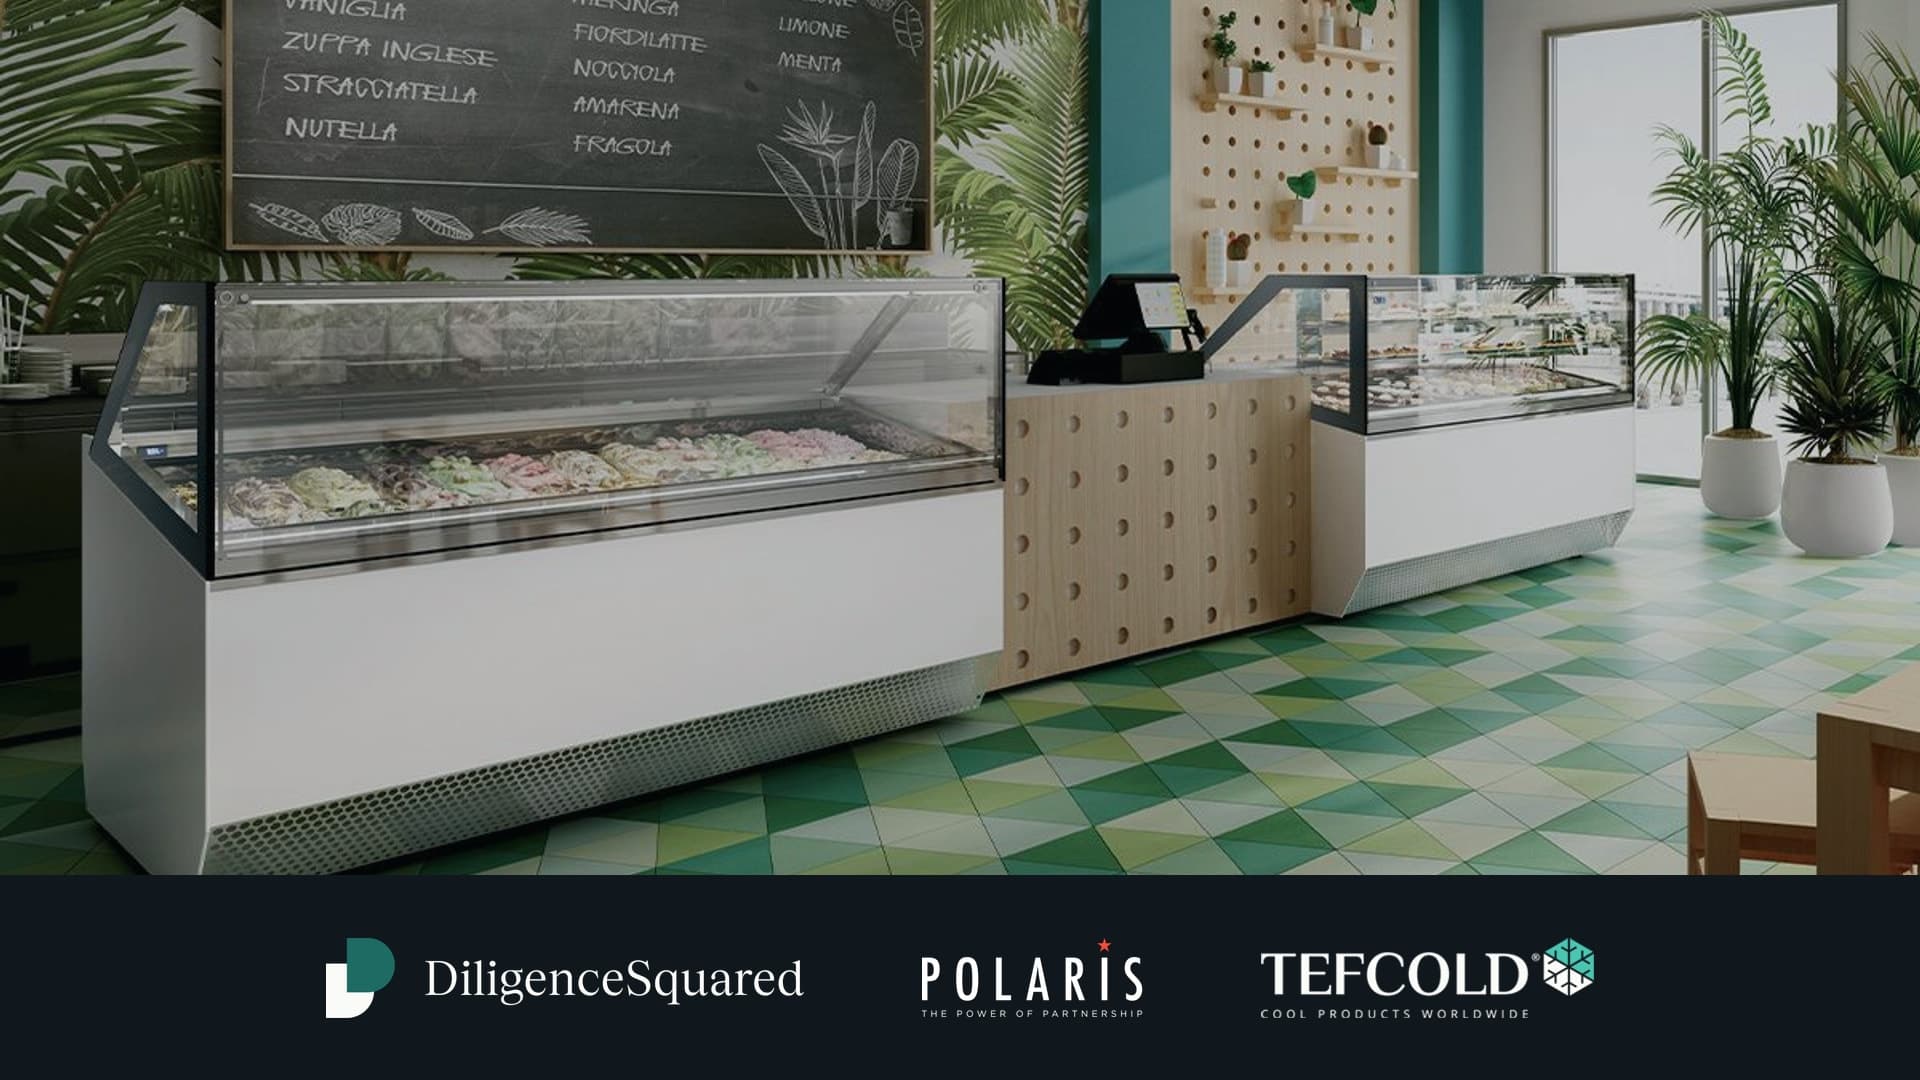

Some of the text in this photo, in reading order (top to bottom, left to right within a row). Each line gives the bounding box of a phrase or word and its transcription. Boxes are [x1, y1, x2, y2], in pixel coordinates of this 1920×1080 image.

[573, 22, 708, 54] FIORDILATTE
[778, 15, 850, 39] LIMONE
[281, 31, 499, 68] ZUPPA INGLESE
[778, 50, 843, 73] MENTA
[573, 58, 676, 84] NOCCIOLA
[282, 72, 479, 104] STRACCIATELLA
[573, 95, 680, 120] AMARENA
[284, 116, 399, 141] NUTELLA
[573, 134, 673, 157] FRAGOLA
